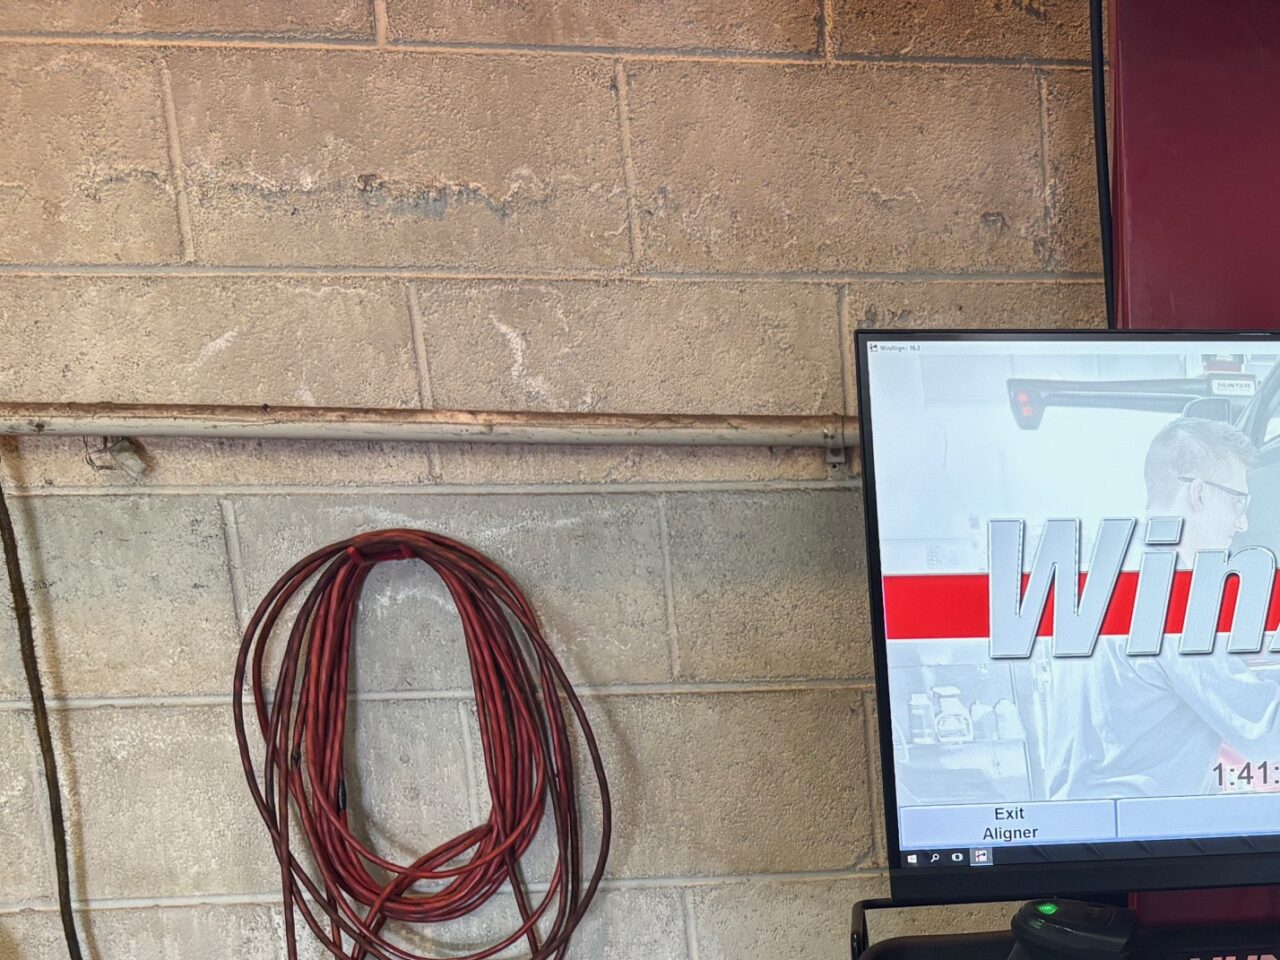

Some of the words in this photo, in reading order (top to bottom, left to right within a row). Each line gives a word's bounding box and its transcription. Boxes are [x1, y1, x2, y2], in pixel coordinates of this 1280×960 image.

[1217, 381, 1251, 389] HUNTER
[994, 806, 1025, 821] Exit
[983, 825, 1039, 842] Aligner
